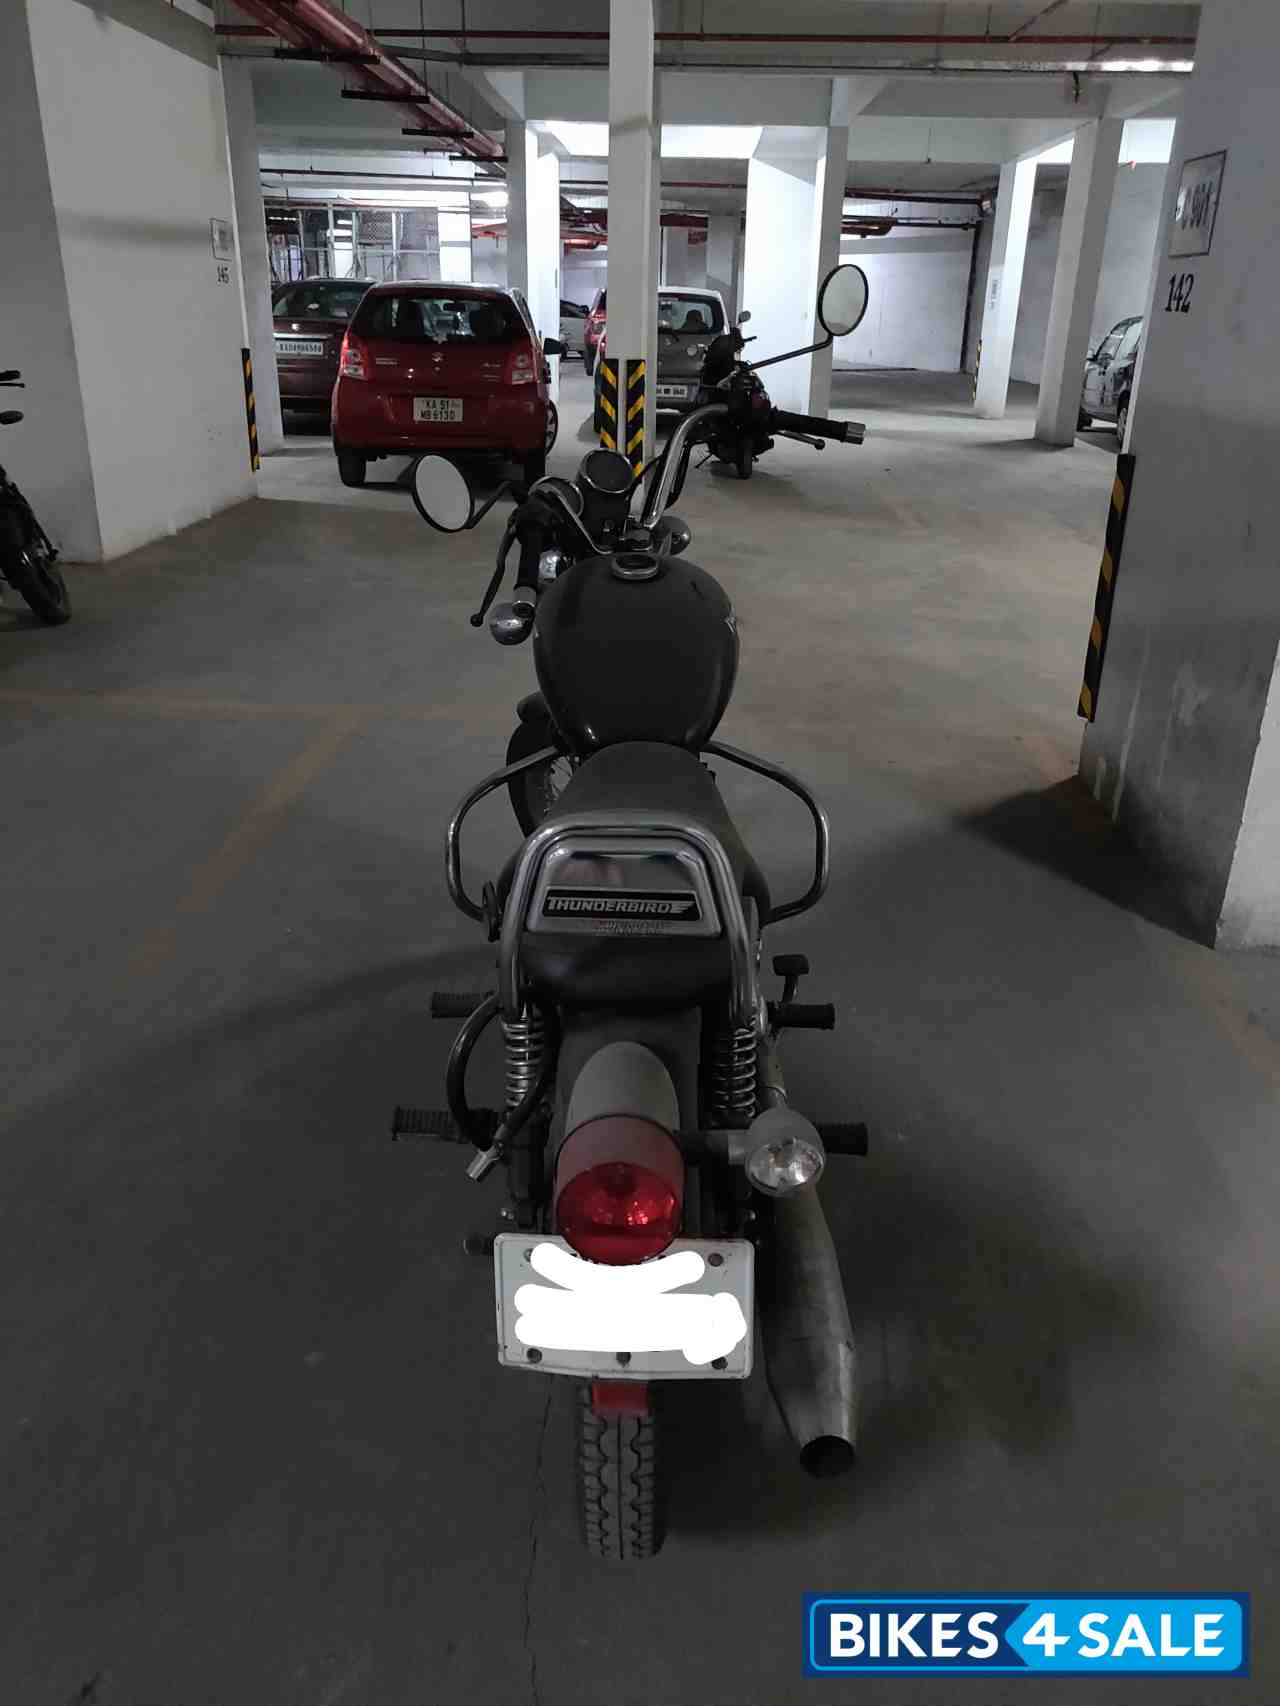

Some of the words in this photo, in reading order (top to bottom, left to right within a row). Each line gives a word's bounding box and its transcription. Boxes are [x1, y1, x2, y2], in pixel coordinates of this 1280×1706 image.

[1165, 273, 1194, 313] 142
[422, 399, 438, 409] KA
[547, 898, 672, 914] THUNDERBIRD
